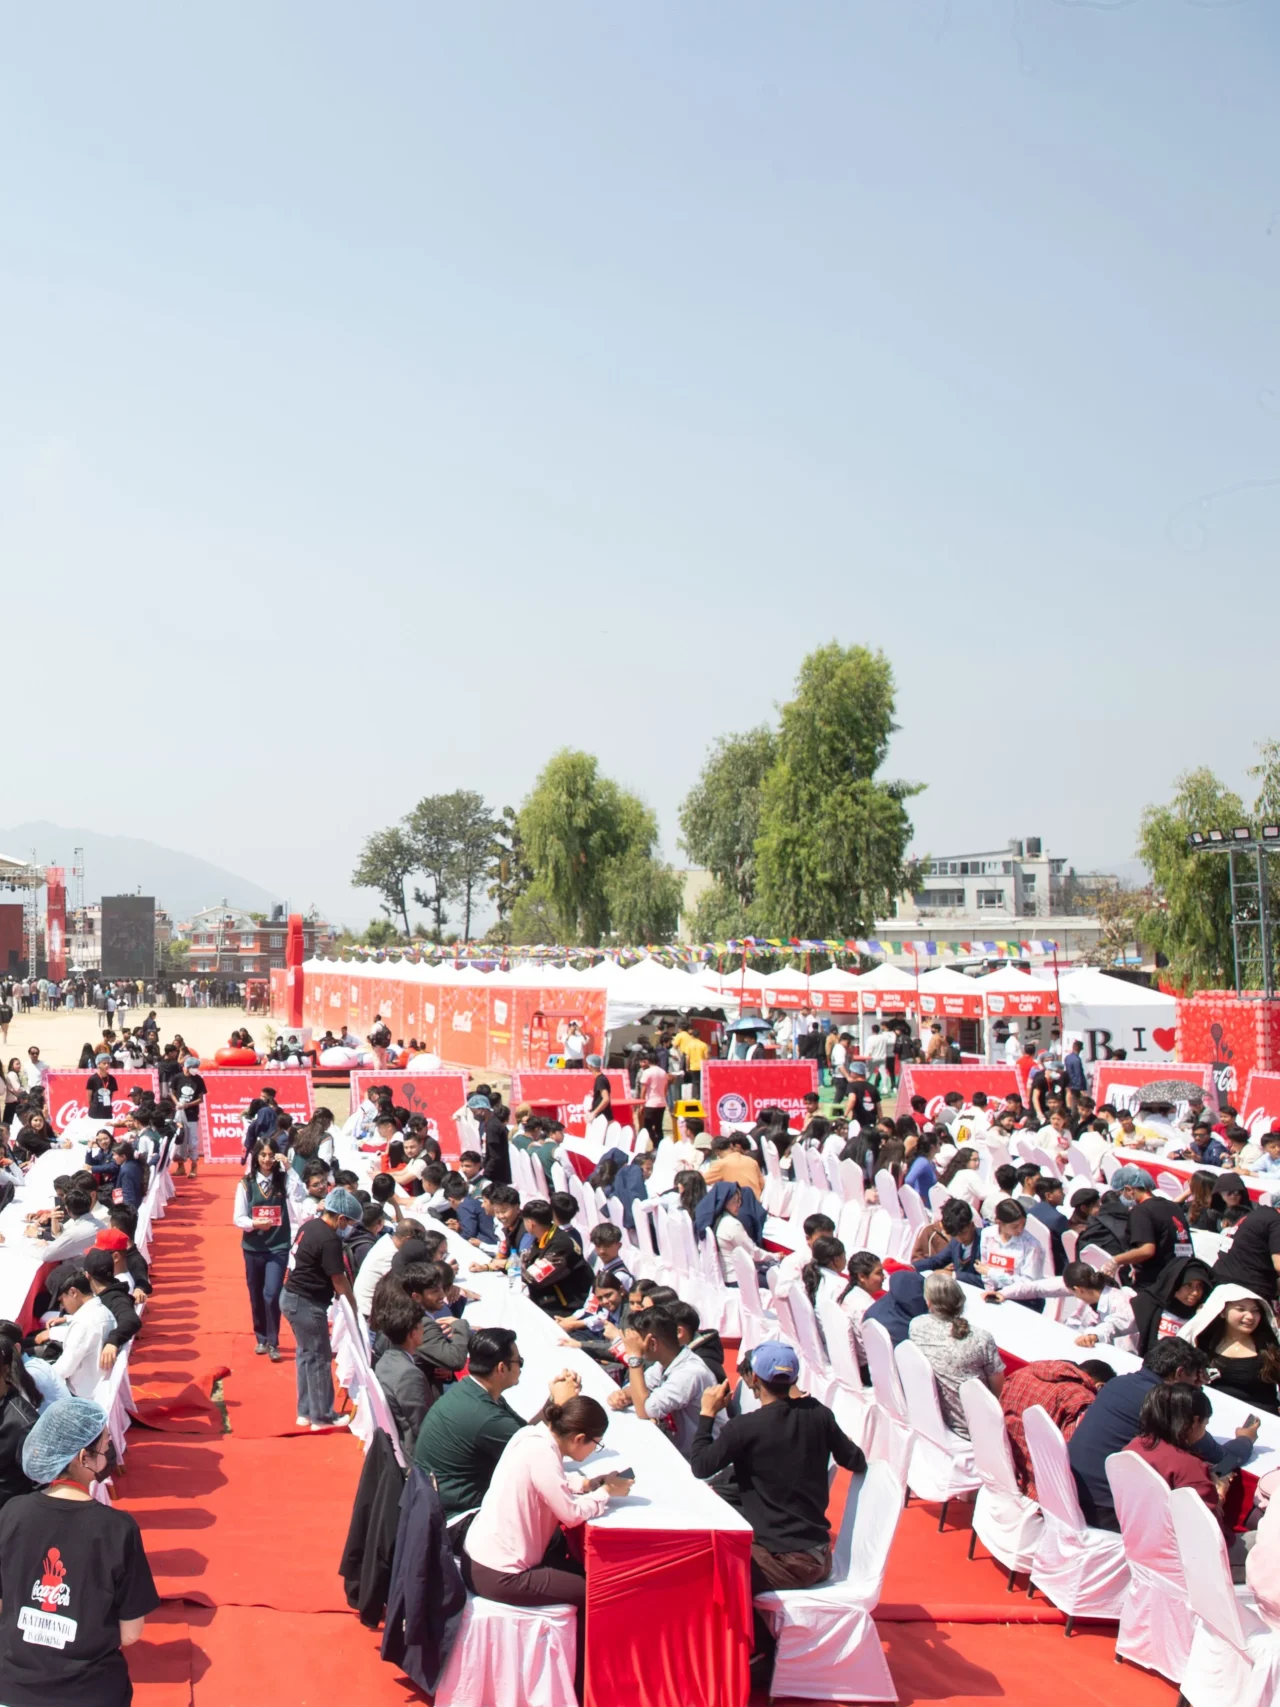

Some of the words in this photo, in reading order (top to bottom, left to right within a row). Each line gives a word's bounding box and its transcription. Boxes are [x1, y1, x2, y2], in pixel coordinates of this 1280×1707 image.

[1085, 1029, 1114, 1062] B
[754, 1098, 806, 1109] OFFICIAL
[211, 1113, 240, 1124] THE
[258, 1208, 275, 1217] 246
